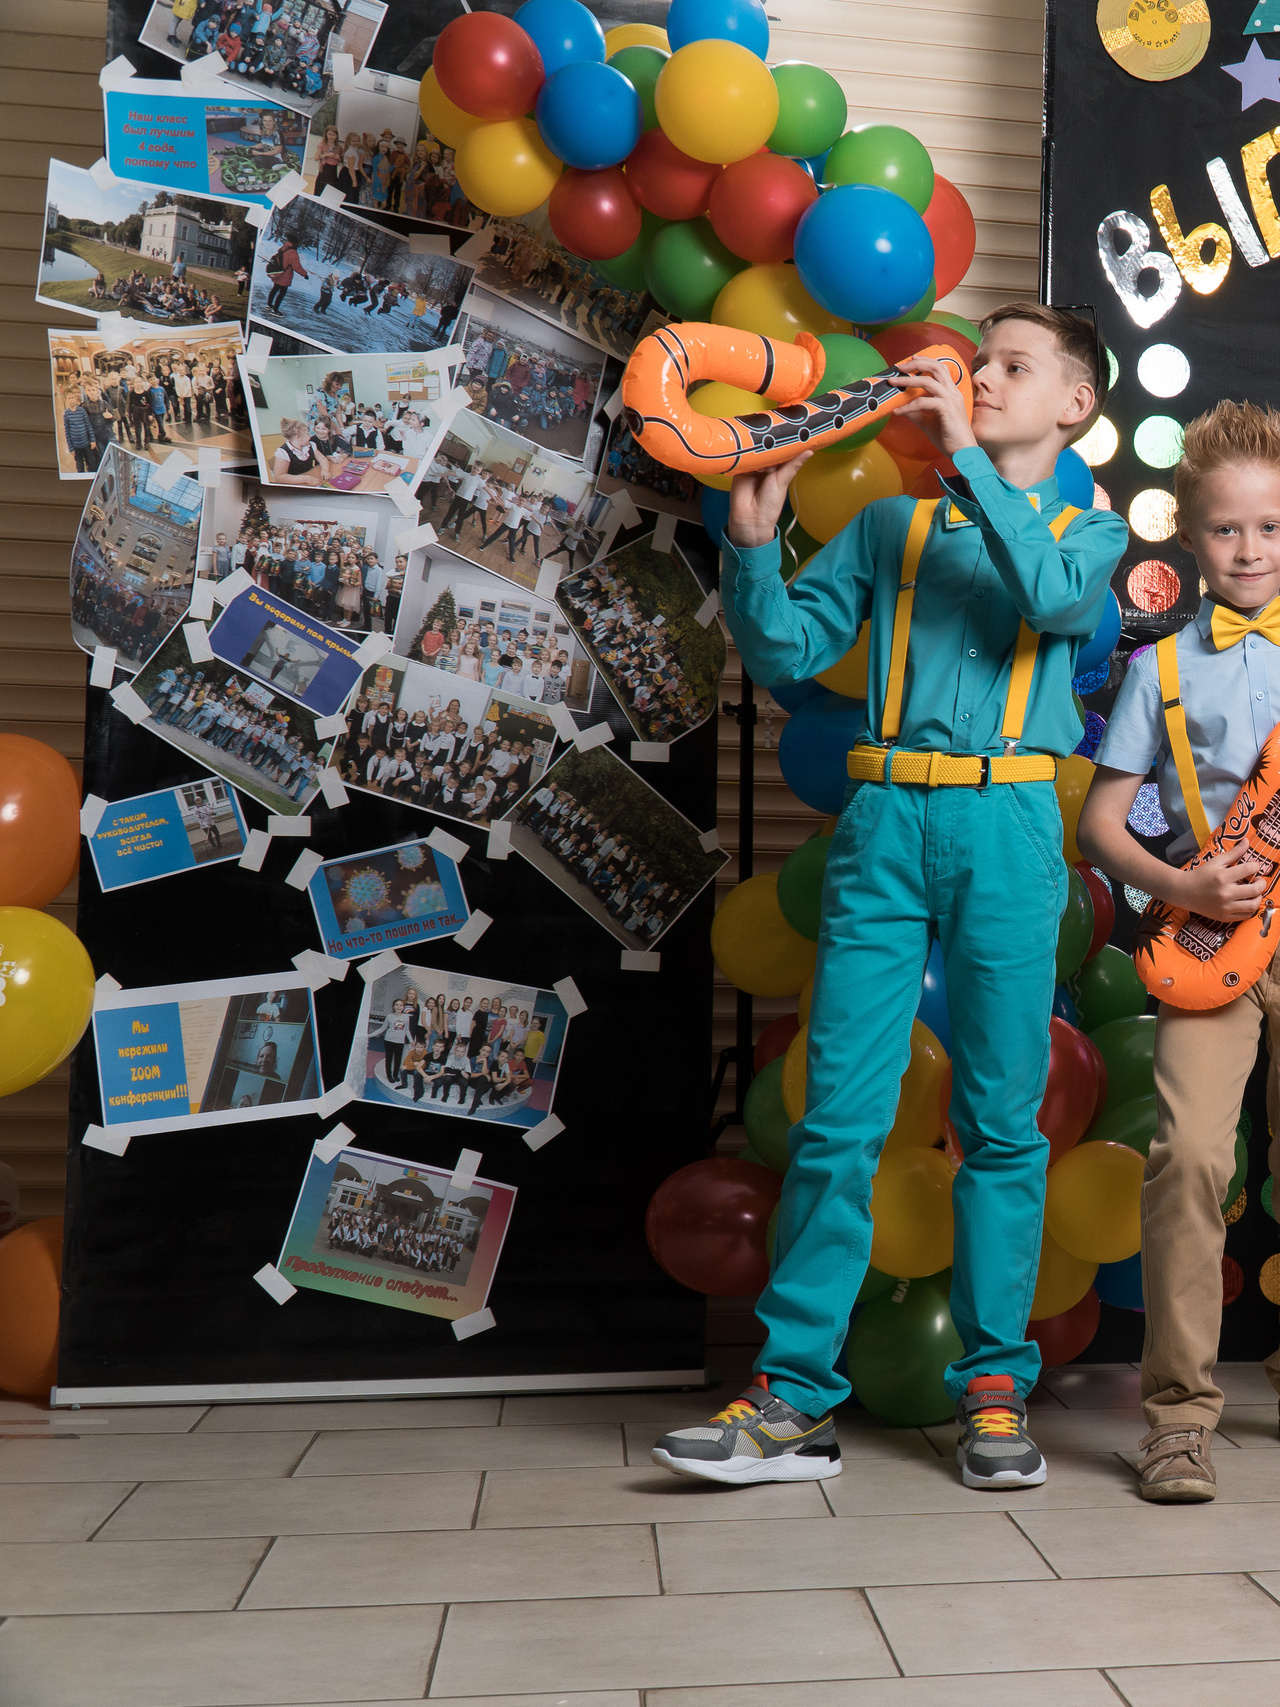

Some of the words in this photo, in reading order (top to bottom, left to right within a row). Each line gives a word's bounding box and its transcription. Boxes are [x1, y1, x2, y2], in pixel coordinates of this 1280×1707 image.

[128, 110, 153, 122] Наш
[156, 115, 188, 124] класс
[122, 123, 147, 136] был
[148, 127, 195, 138] лучшим
[138, 141, 146, 151] 4
[147, 142, 178, 154] года,
[124, 157, 170, 170] потому
[173, 160, 197, 169] что
[248, 592, 264, 606] Вы
[264, 603, 306, 631] подарили
[306, 624, 325, 642] нам
[325, 639, 356, 661] крыль
[112, 819, 119, 827] С
[118, 812, 148, 825] ТАКИМ
[120, 832, 152, 846] ВСЕГДА
[116, 846, 133, 857] ВСЁ
[134, 839, 164, 852] ЧИСТО!
[327, 939, 344, 954] Но
[345, 932, 383, 950] что-то
[384, 922, 420, 940] пошло
[422, 920, 436, 932] не
[131, 1020, 150, 1034] Мы
[118, 1043, 168, 1059] пережили
[130, 1065, 161, 1081] ZOOM
[108, 1083, 188, 1107] конференции!!!
[284, 1255, 384, 1288] Продолжение
[385, 1278, 459, 1302] следует...
